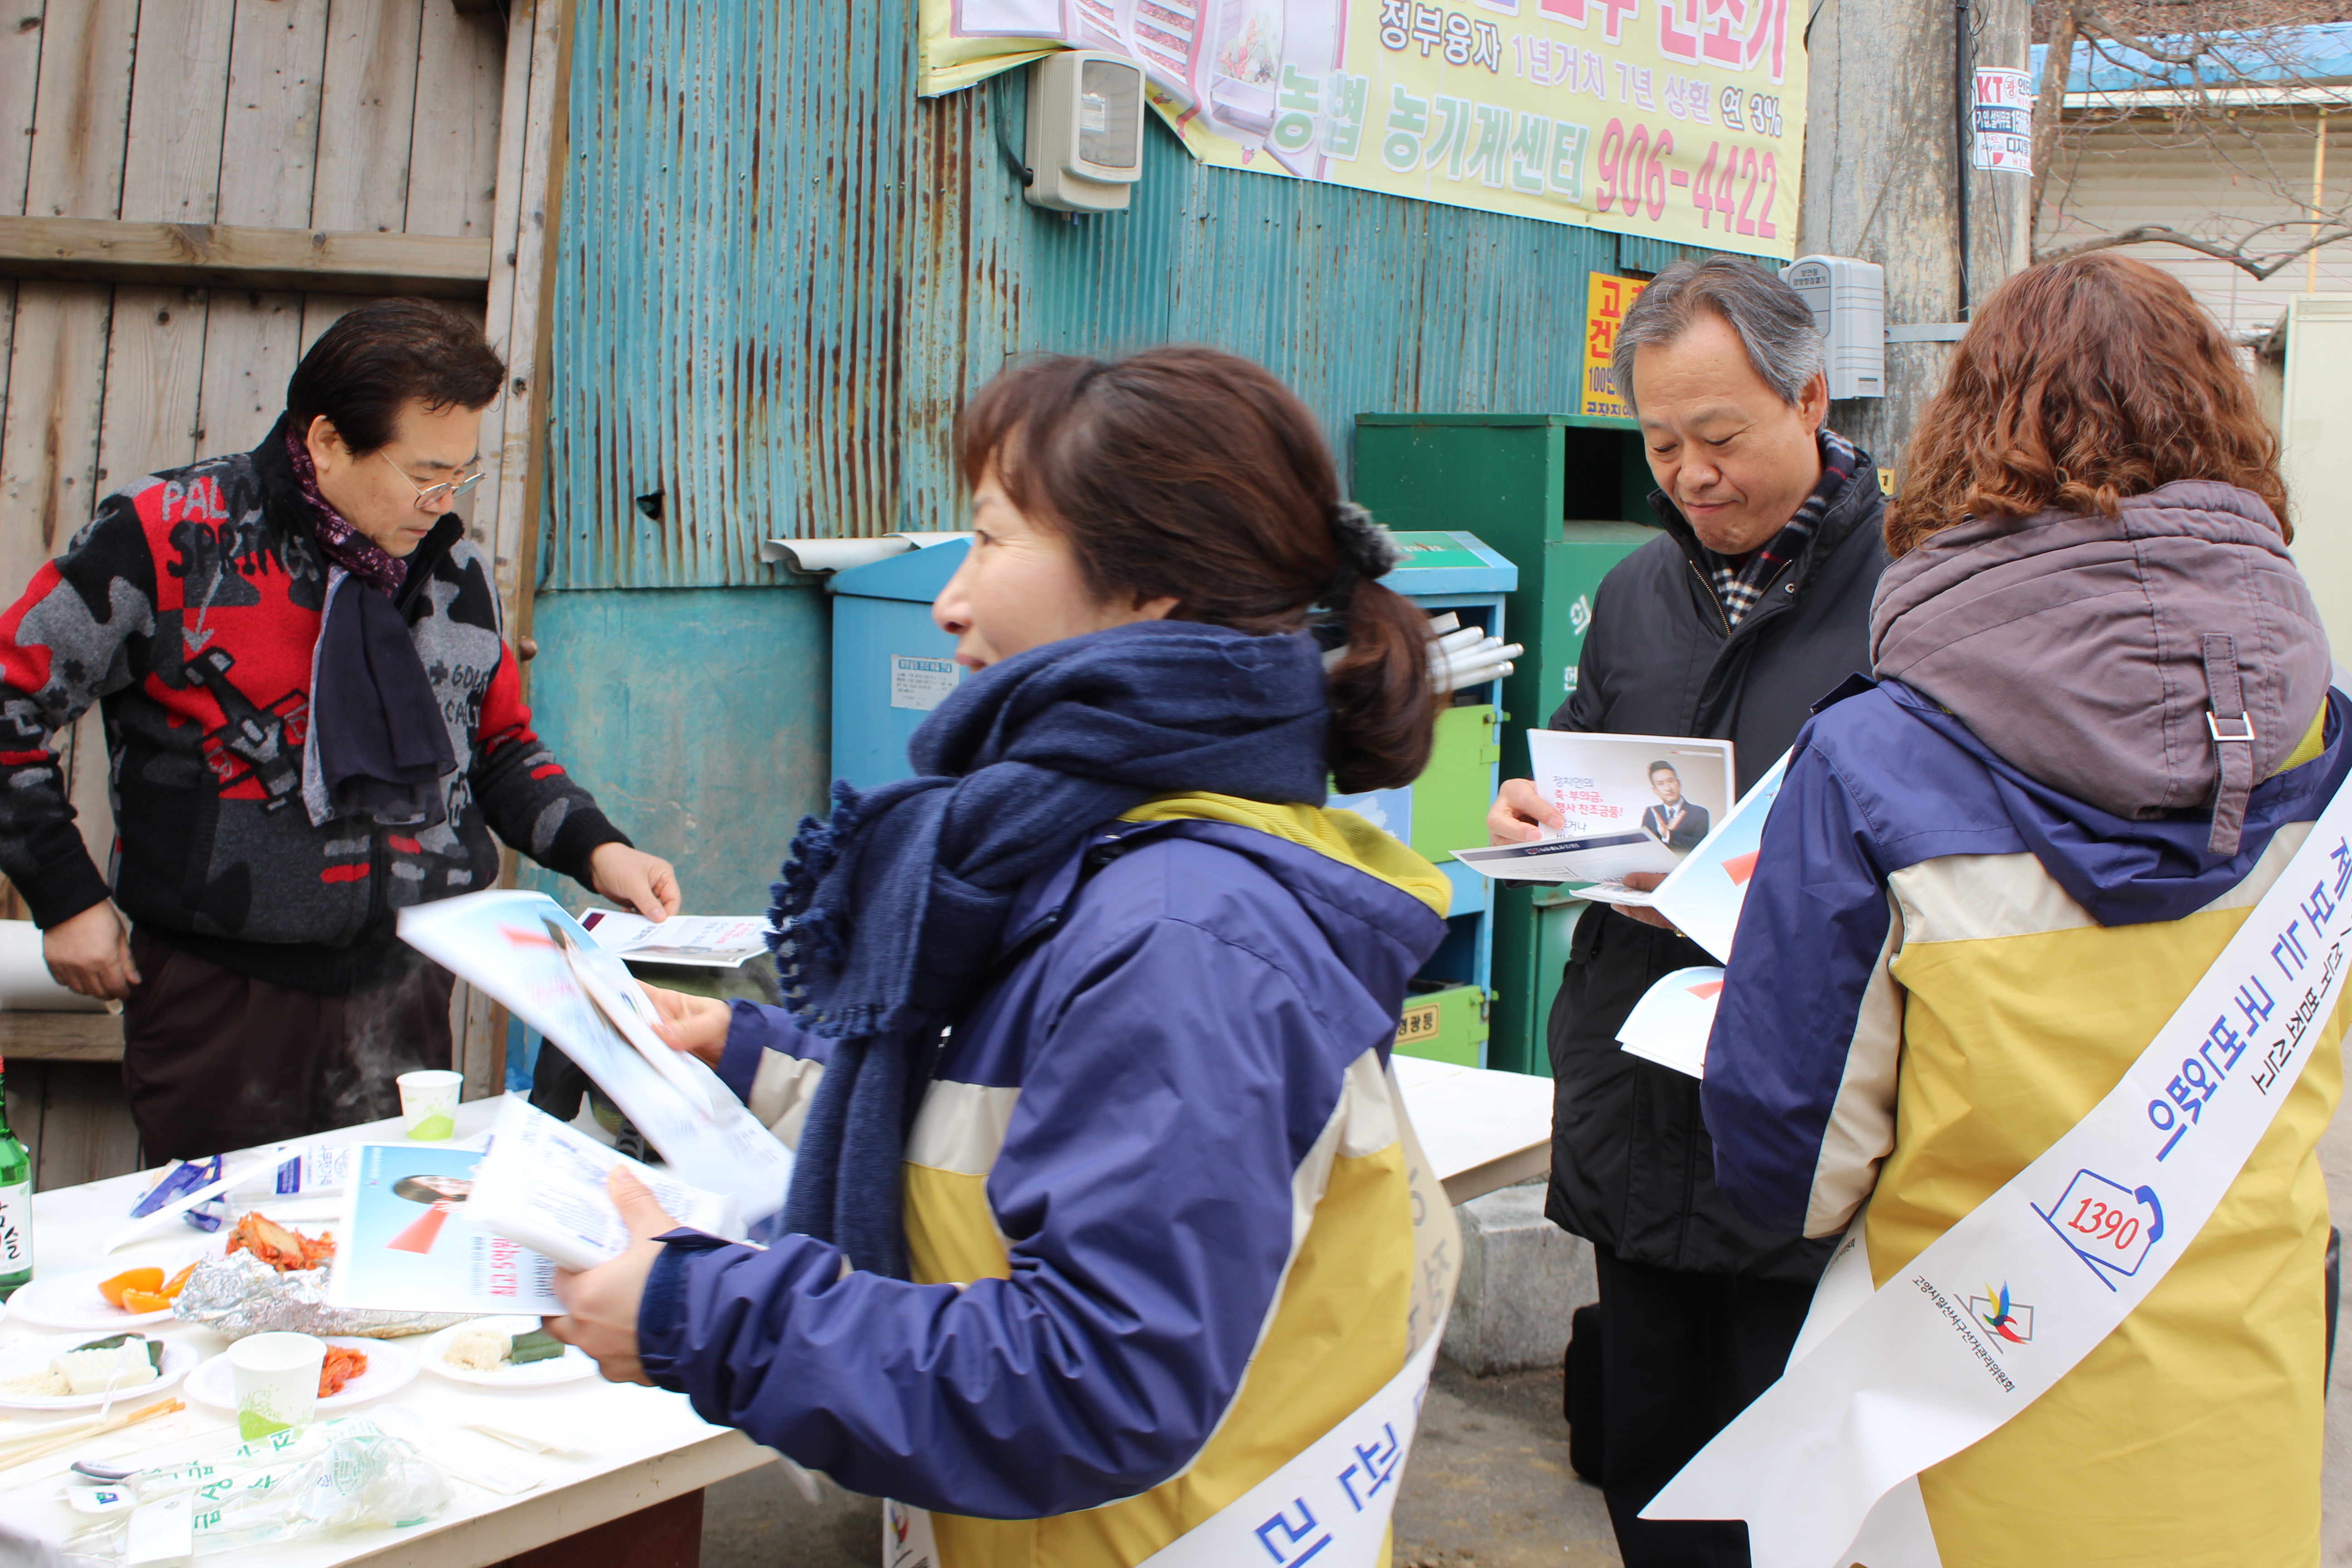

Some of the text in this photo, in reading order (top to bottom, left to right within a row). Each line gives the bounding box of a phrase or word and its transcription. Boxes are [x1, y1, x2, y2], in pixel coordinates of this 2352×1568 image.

[1379, 0, 1501, 73] 정부융자
[1512, 34, 1606, 101] 1년거치
[1614, 62, 1656, 113] 7년
[1664, 75, 1713, 126] 상환
[1720, 86, 1744, 131] 연
[1750, 93, 1782, 137] 3%
[1977, 76, 2003, 103] KT
[1274, 62, 1776, 240] 농협 농기계센터 906-4422
[1556, 802, 1576, 814] 행사
[2067, 1197, 2139, 1250] 1390
[489, 1273, 518, 1297] 최고
